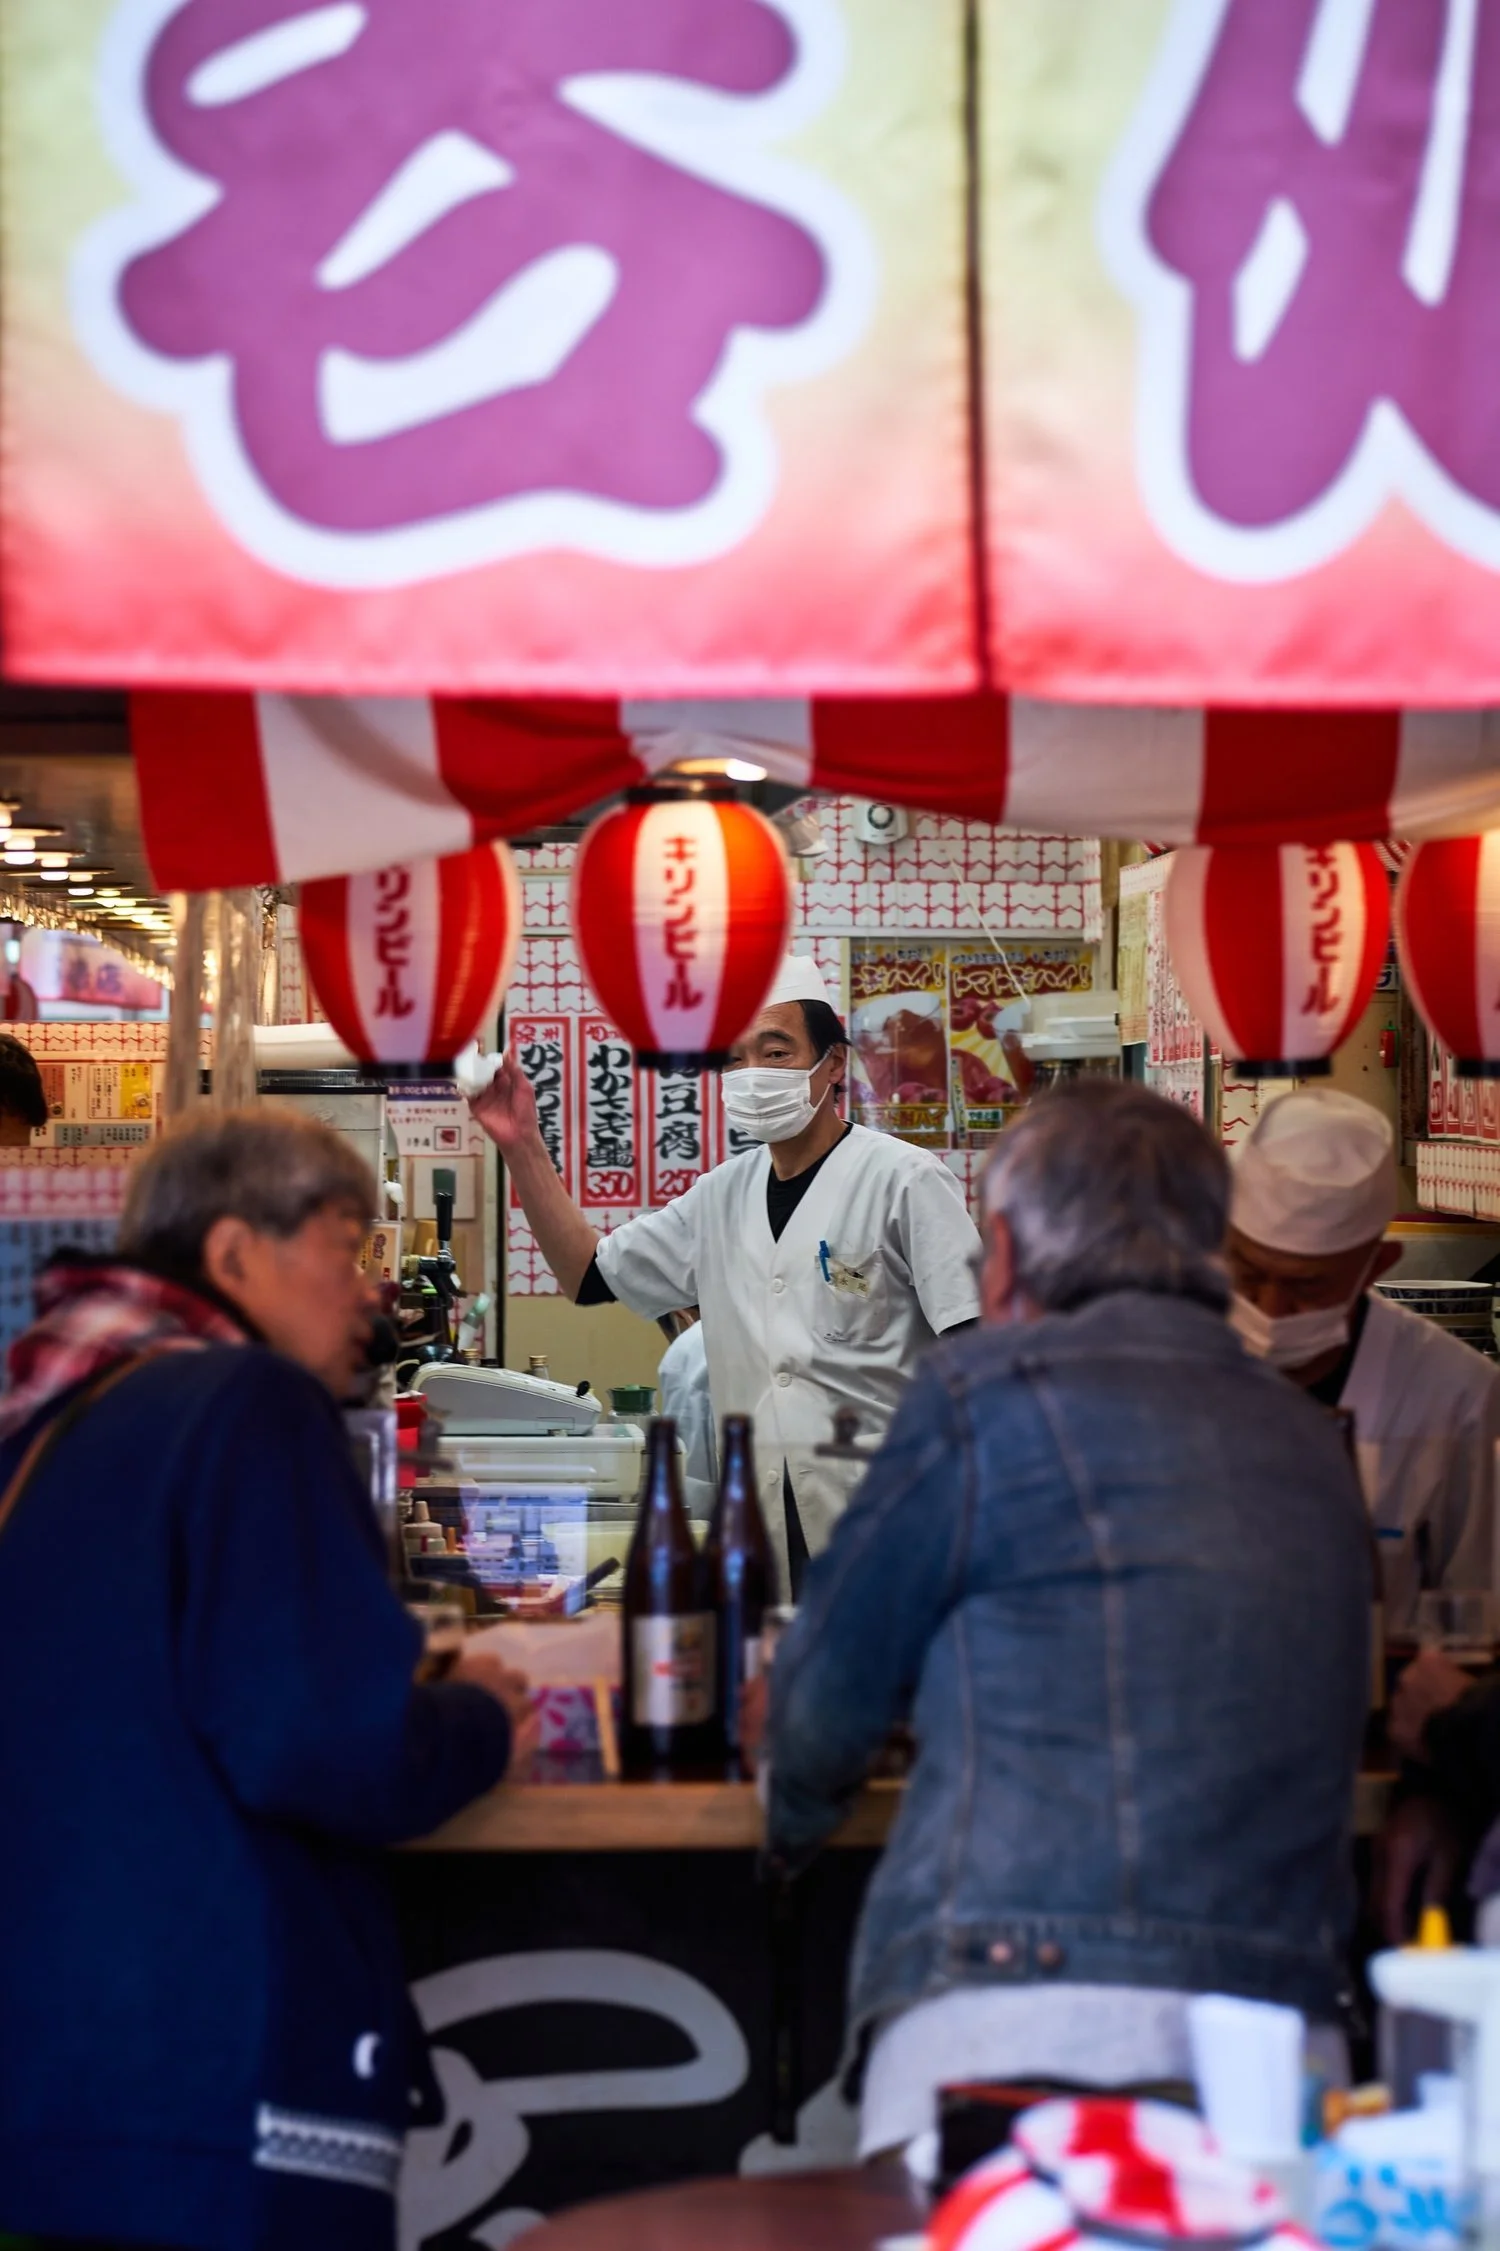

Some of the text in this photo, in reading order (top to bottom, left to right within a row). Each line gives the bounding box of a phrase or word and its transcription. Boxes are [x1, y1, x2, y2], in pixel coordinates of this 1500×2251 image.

[373, 863, 415, 1020] リンビール
[663, 835, 704, 1012] キリンビール
[586, 1171, 635, 1198] 350
